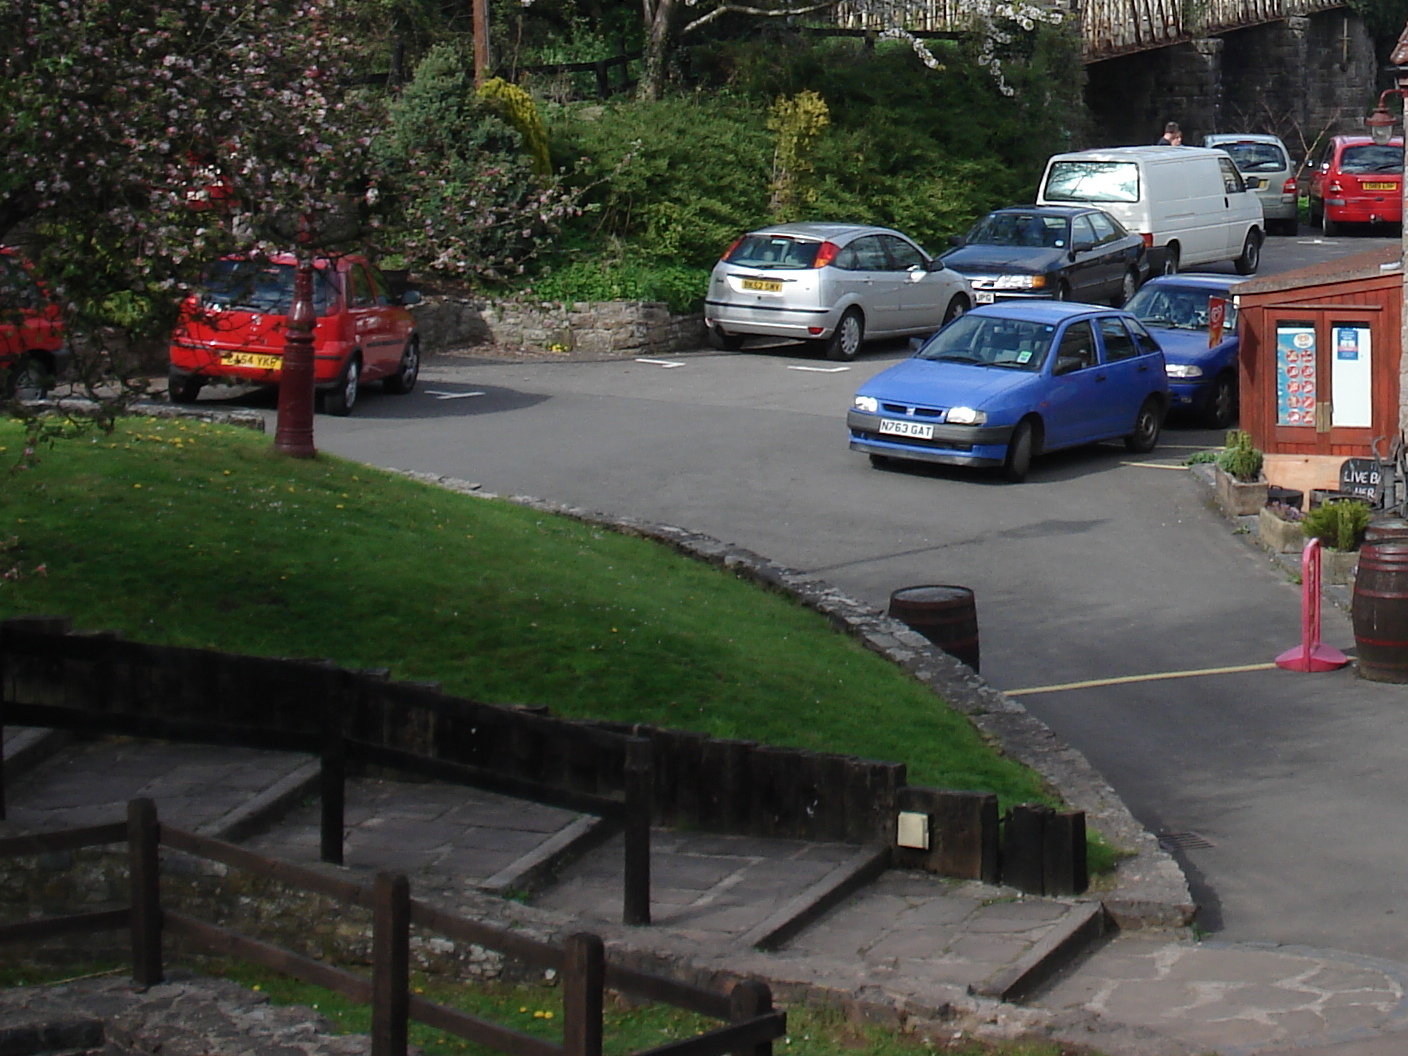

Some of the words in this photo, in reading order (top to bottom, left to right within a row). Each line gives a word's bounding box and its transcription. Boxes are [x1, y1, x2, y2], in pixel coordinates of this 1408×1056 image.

[881, 420, 909, 433] N763
[910, 424, 932, 436] GAT
[1343, 470, 1369, 483] LIVE
